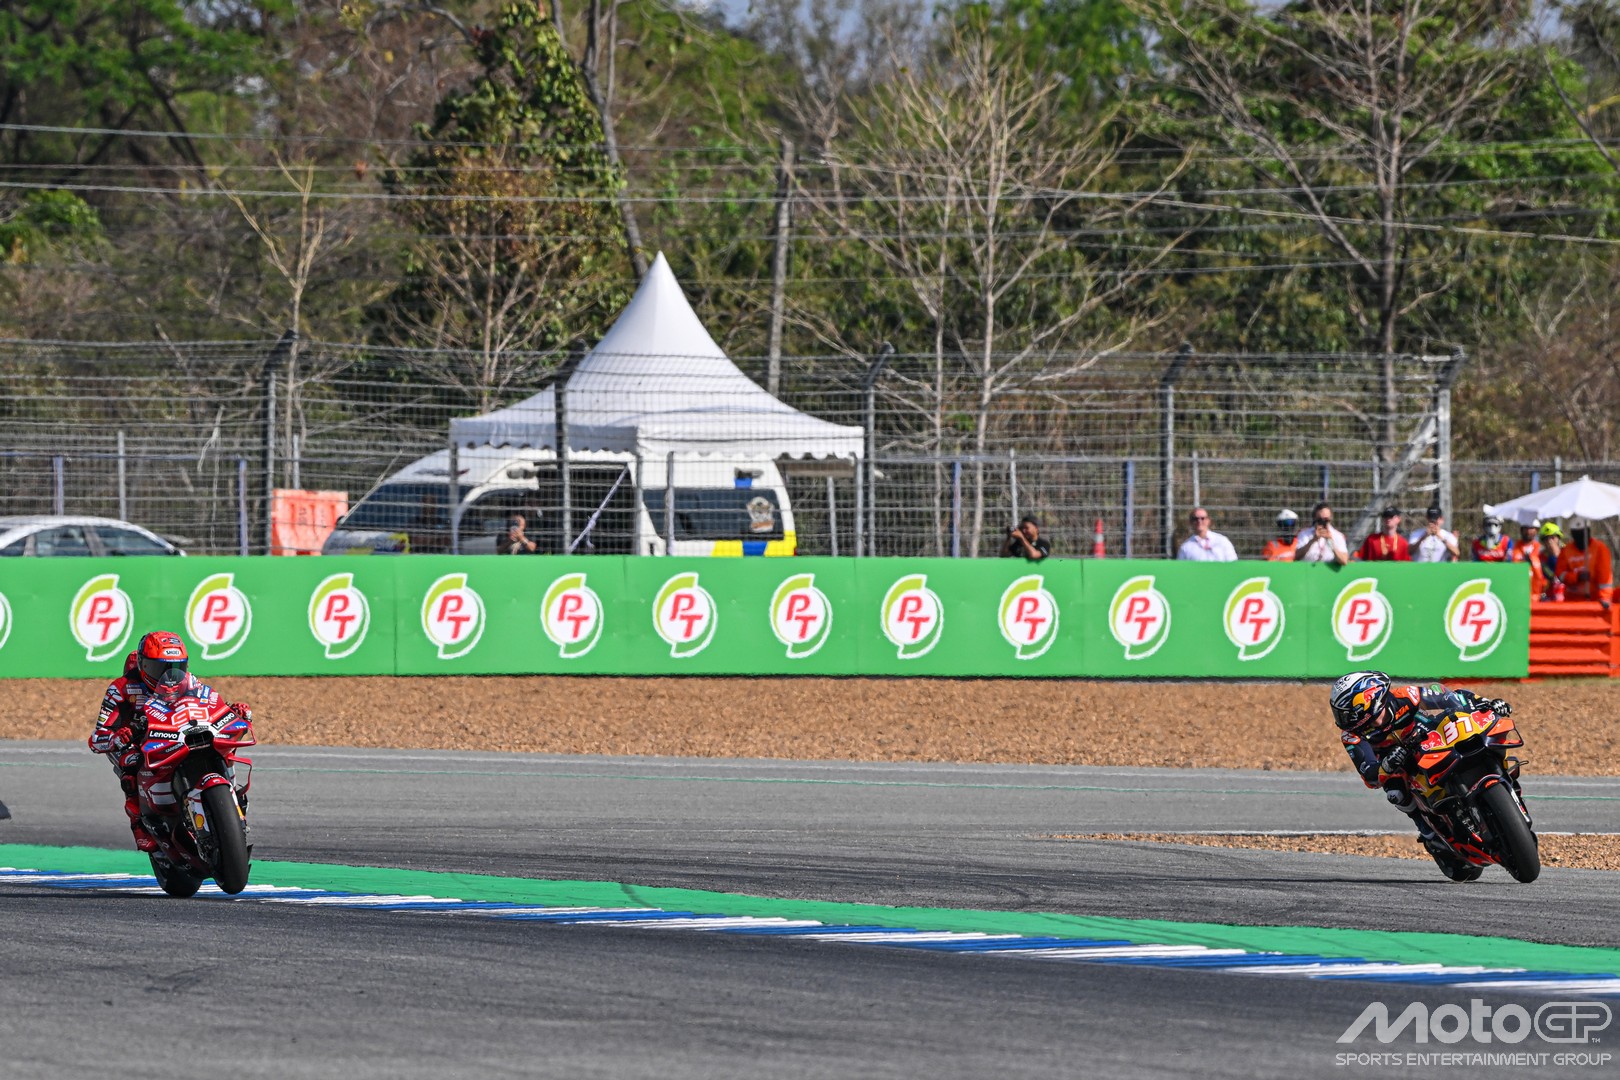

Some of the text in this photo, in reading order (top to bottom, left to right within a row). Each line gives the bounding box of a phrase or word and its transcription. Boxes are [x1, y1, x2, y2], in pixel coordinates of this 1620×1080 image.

[88, 596, 120, 642] PT
[202, 595, 236, 640] PT
[324, 595, 355, 639] PT
[438, 595, 470, 639] PT
[558, 595, 590, 638] PT
[670, 594, 703, 638] PT
[786, 594, 817, 639] PT
[898, 596, 930, 639] PT
[1015, 597, 1046, 640] PT
[1125, 597, 1156, 640] PT
[1240, 598, 1270, 641] PT
[1348, 599, 1378, 641] PT
[1460, 600, 1491, 642] PT
[149, 731, 178, 739] Lenovo
[171, 707, 210, 728] 93
[213, 712, 235, 728] Lenovo
[1443, 716, 1473, 745] 37
